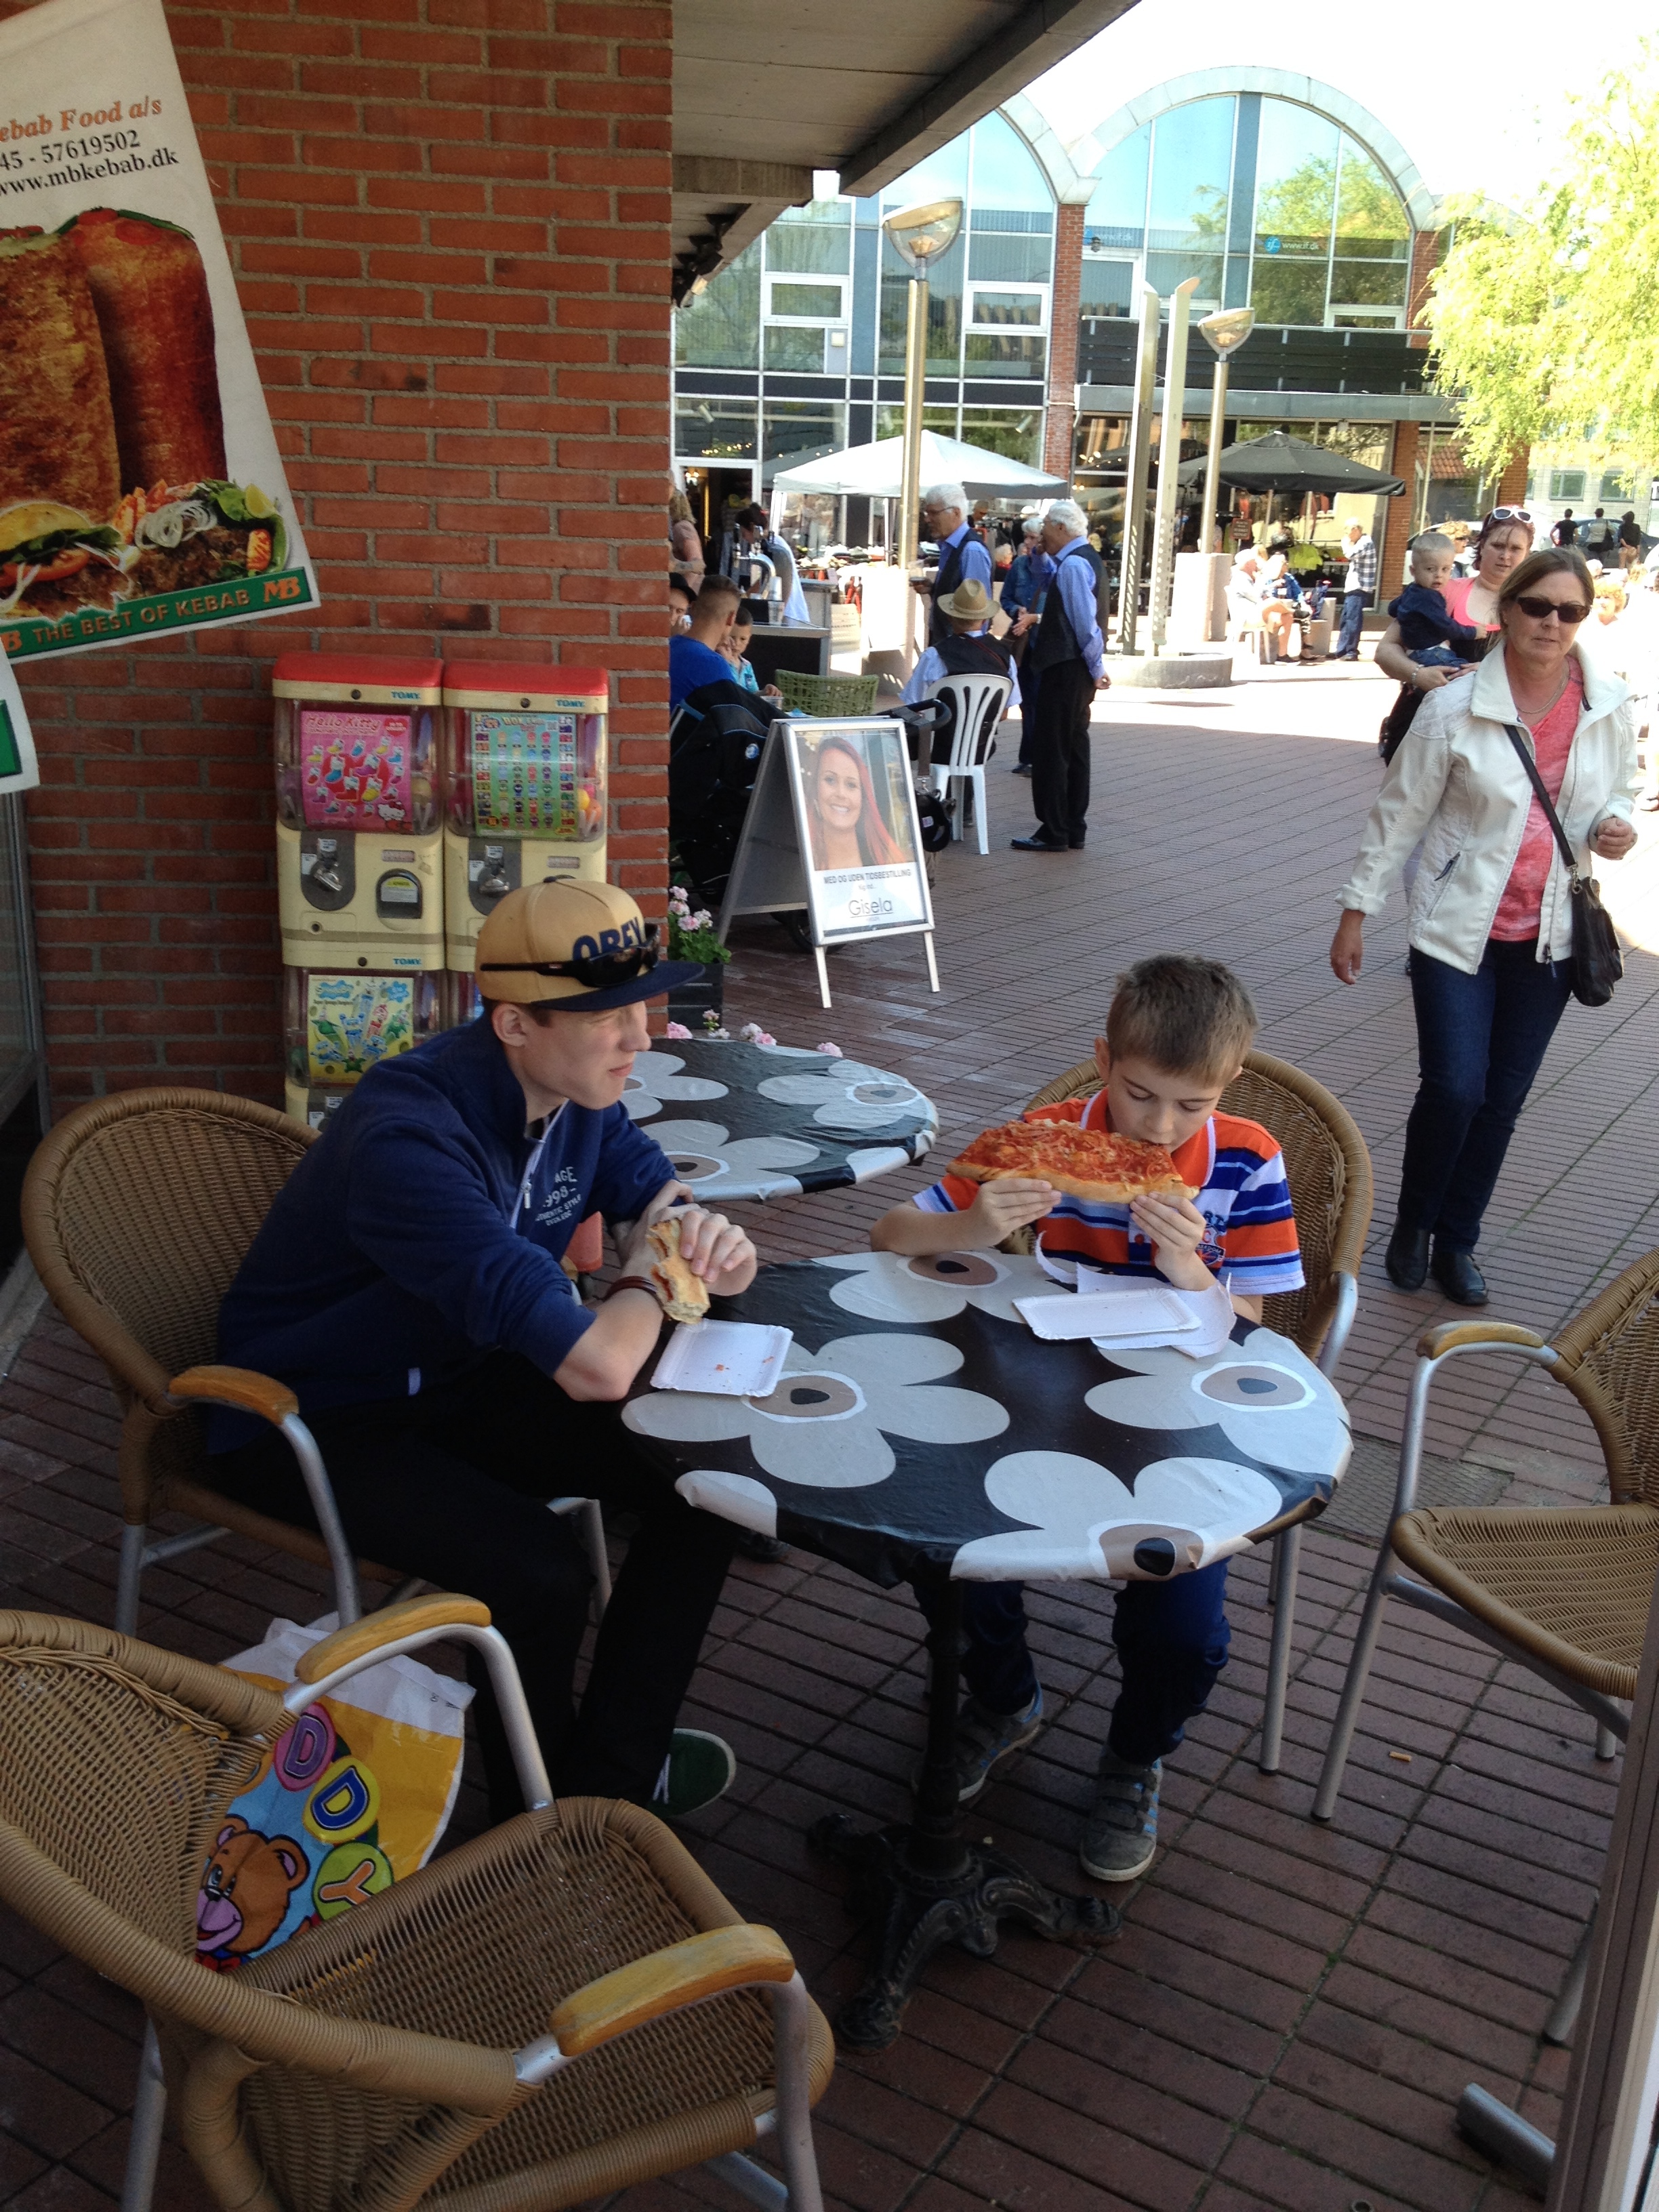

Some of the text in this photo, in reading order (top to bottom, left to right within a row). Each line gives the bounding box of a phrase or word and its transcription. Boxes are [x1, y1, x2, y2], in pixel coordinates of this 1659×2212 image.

[59, 100, 123, 131] Food
[129, 94, 162, 119] a/s
[41, 129, 140, 163] 57619502
[33, 623, 74, 643] THE
[81, 611, 132, 636] BEST
[140, 605, 169, 623] OF
[176, 590, 250, 617] KEBAB
[263, 577, 301, 602] MB
[391, 691, 421, 700] TOMY
[556, 699, 585, 708] TOMY
[848, 897, 893, 916] Gisela
[393, 958, 422, 966] TOMY
